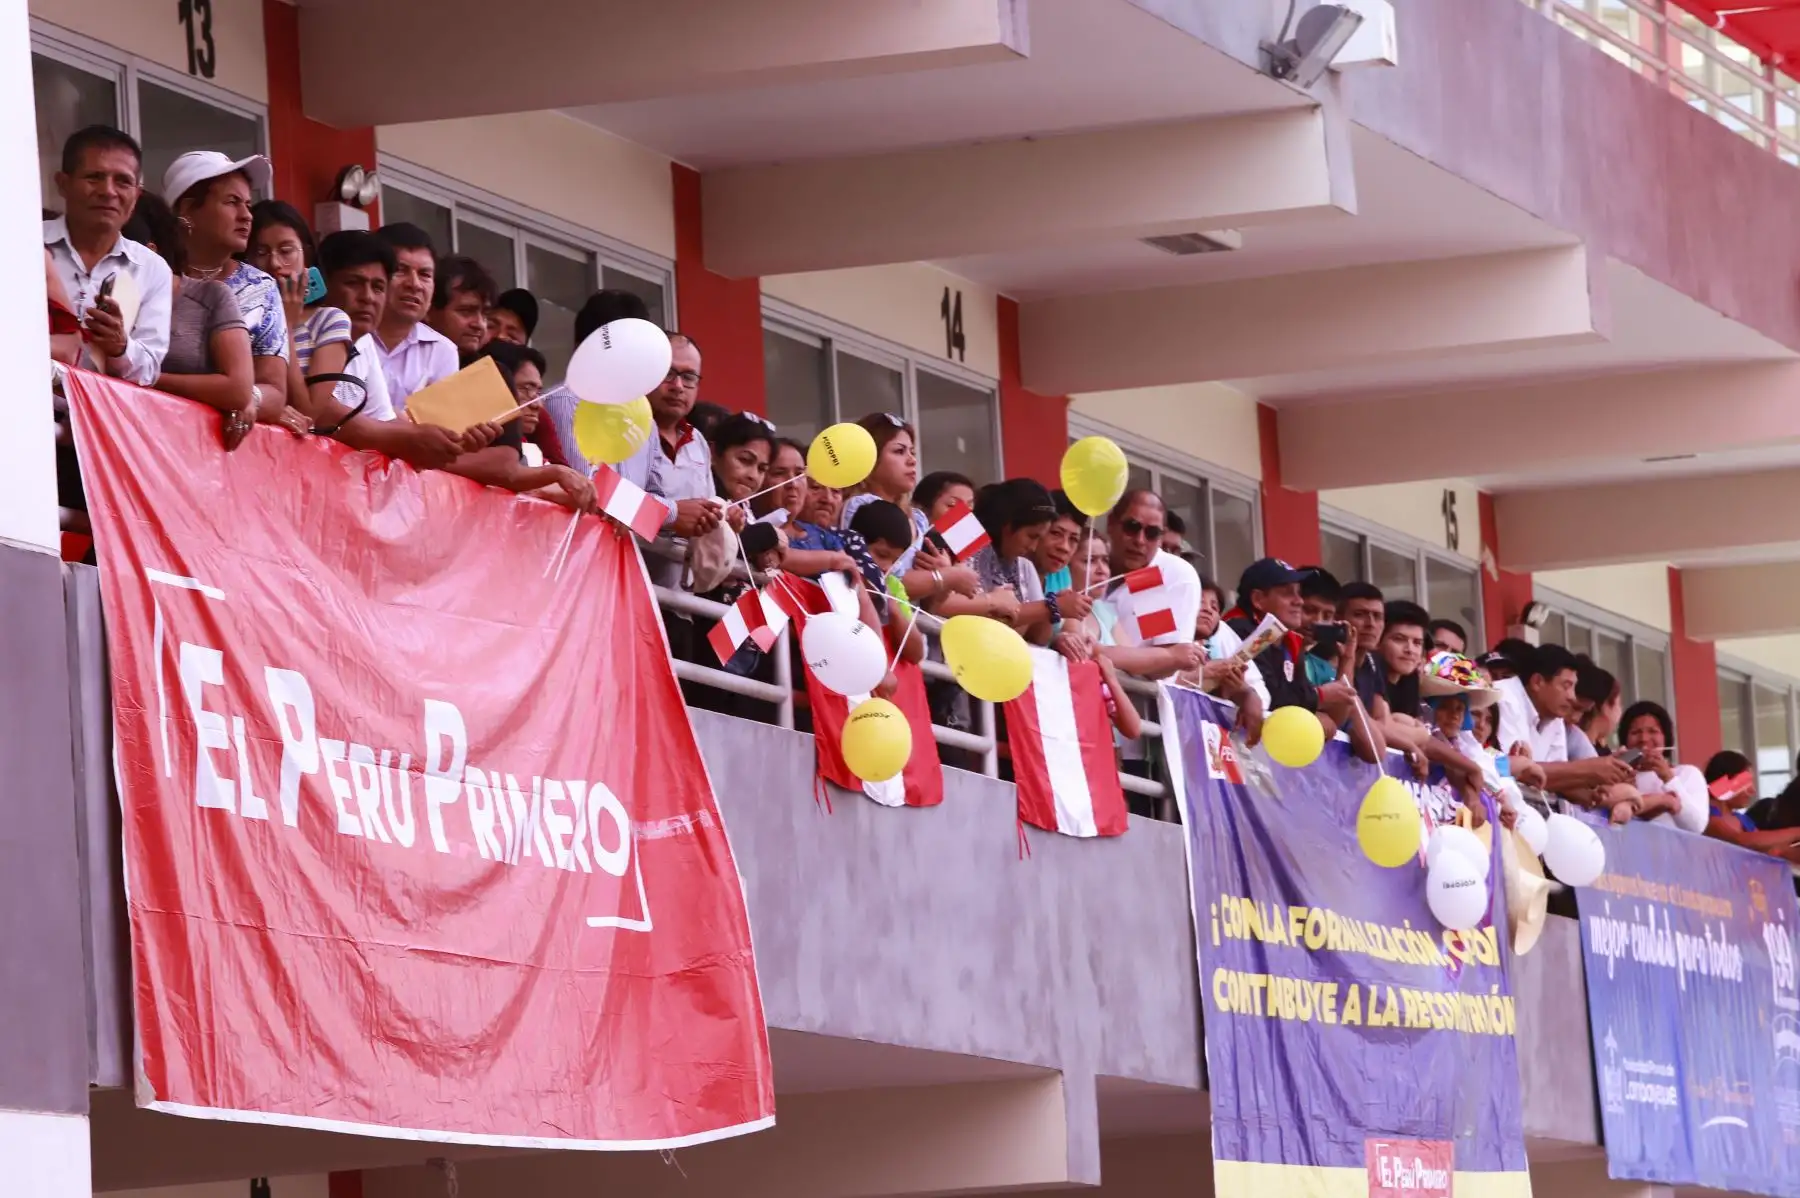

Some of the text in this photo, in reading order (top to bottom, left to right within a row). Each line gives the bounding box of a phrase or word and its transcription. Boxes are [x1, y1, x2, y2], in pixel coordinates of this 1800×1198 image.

[177, 0, 215, 79] 13
[941, 286, 966, 363] 14
[1441, 488, 1459, 551] 15
[179, 640, 269, 821] EL
[423, 698, 631, 877] PRIMERO
[1341, 983, 1362, 1026] A
[1367, 984, 1400, 1027] LA
